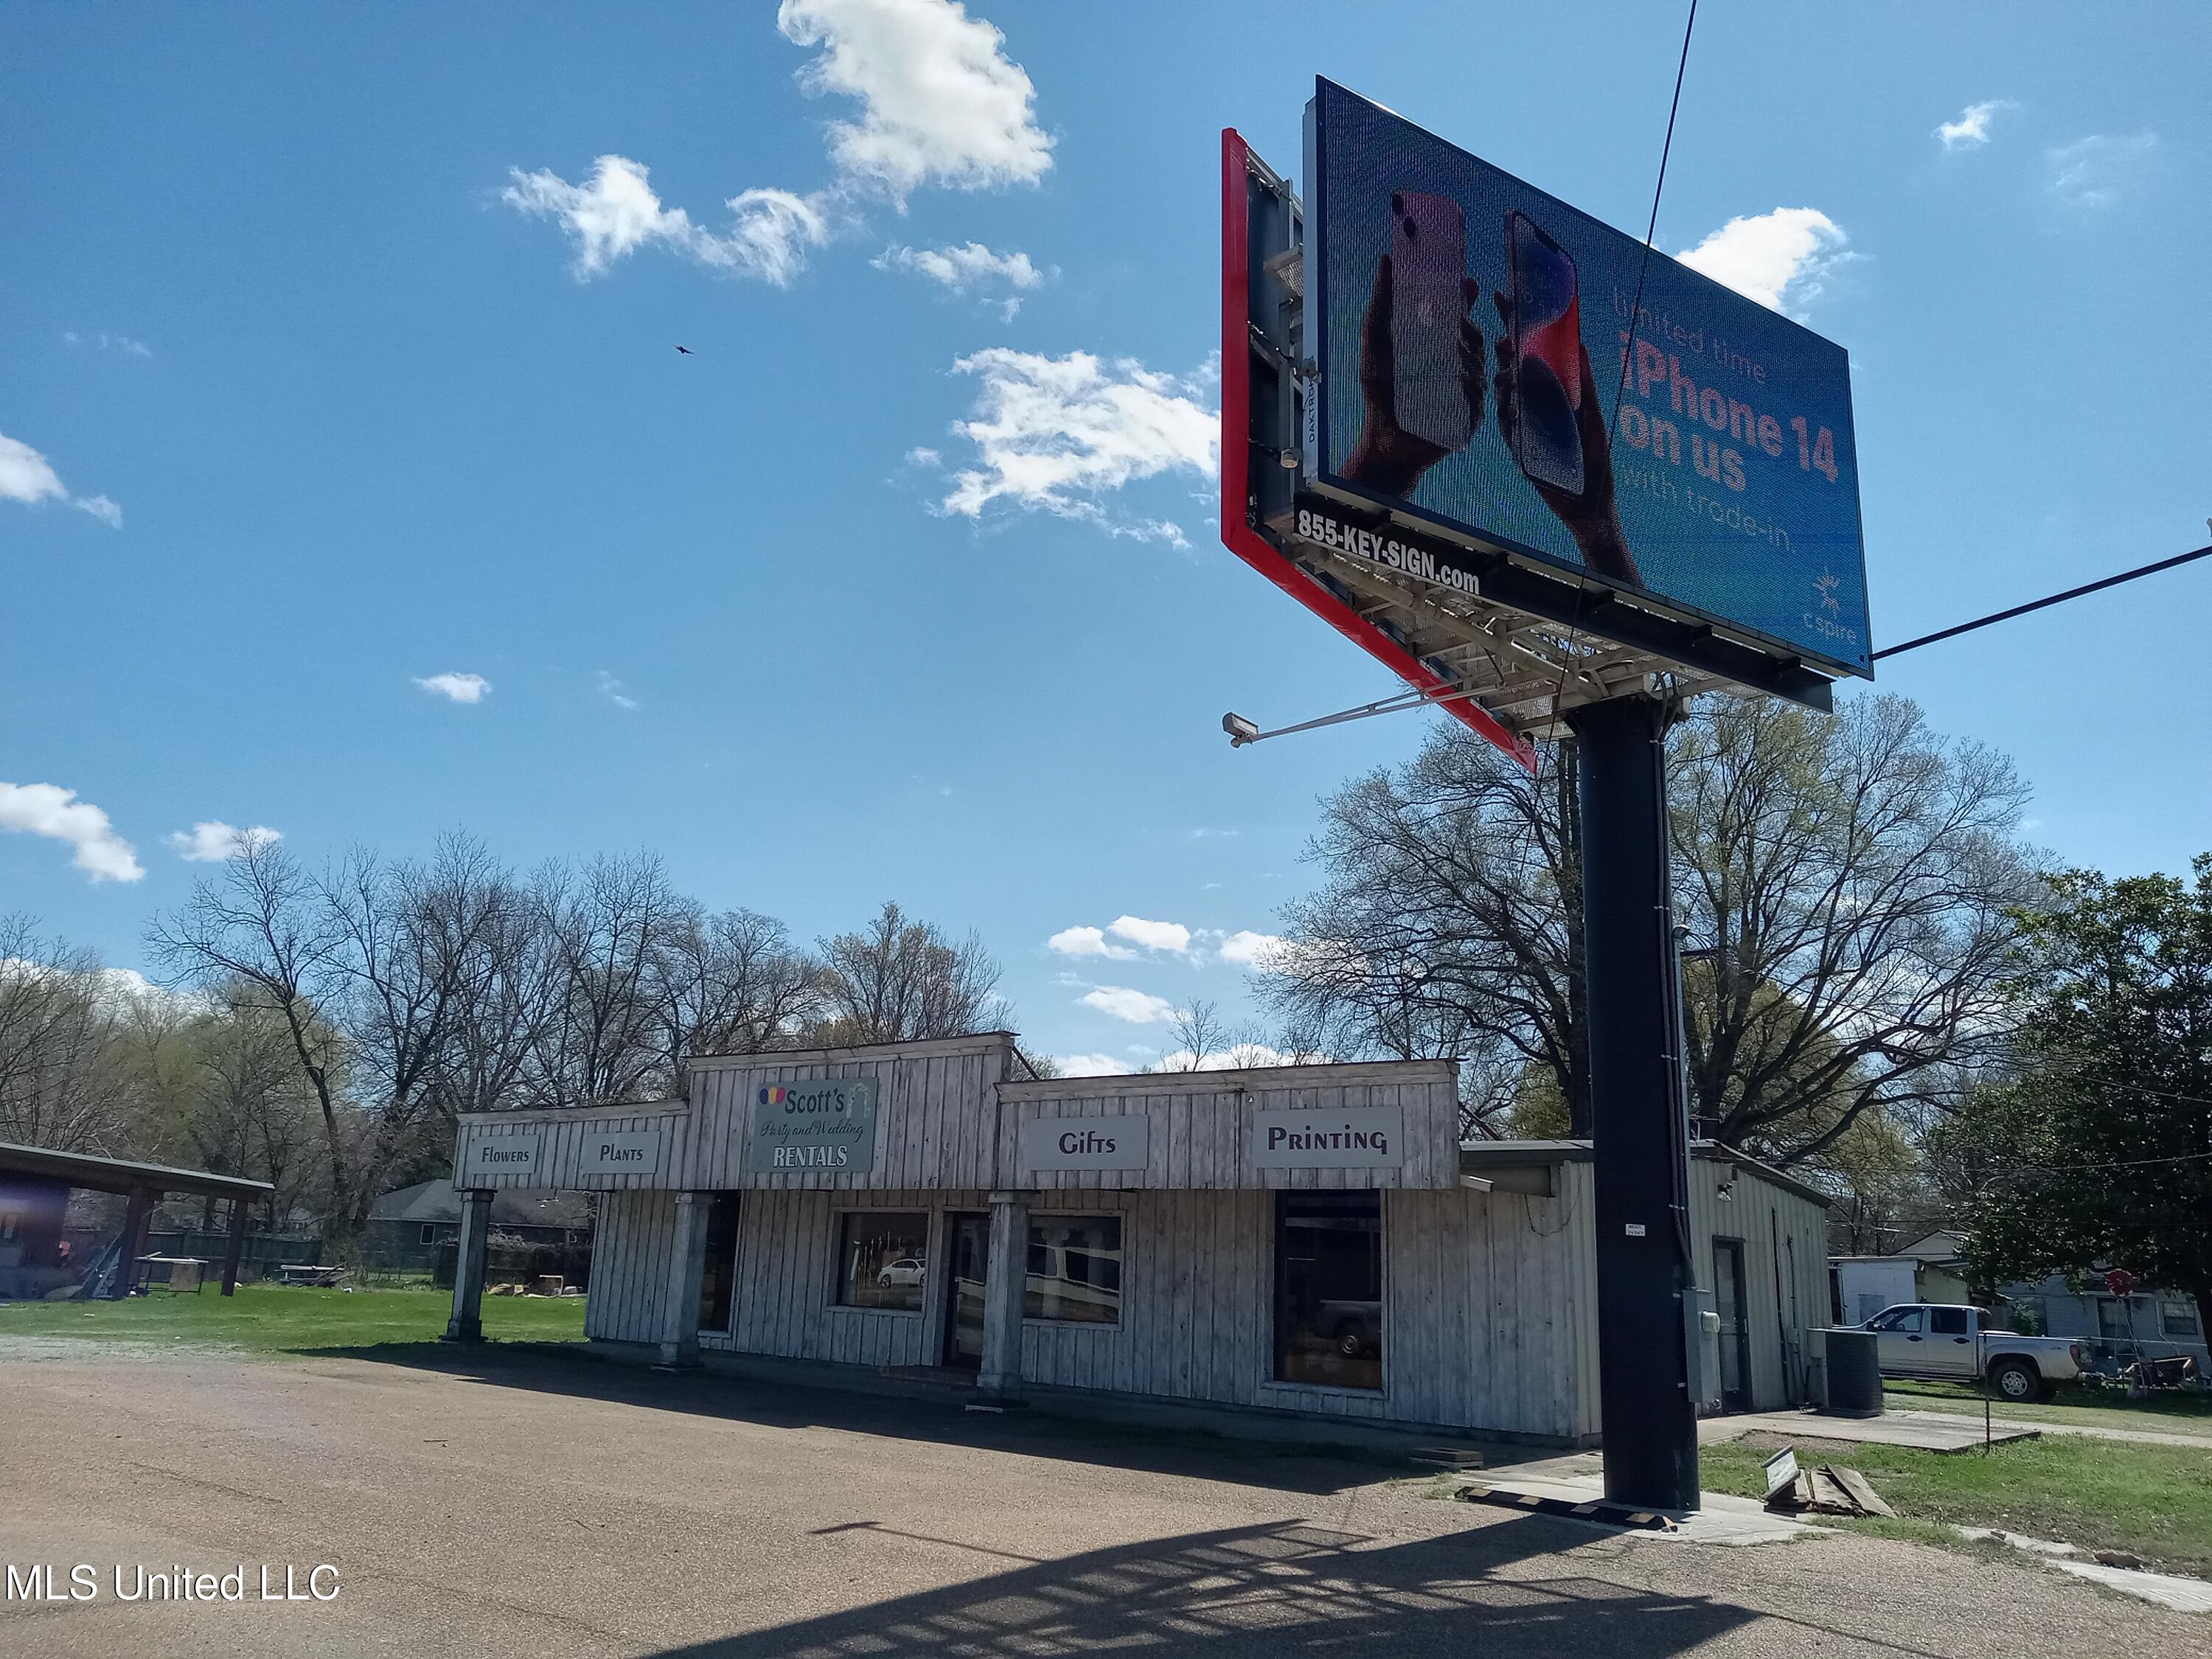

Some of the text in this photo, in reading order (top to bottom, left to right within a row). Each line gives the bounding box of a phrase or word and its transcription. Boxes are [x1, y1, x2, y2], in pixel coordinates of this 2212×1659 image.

[1713, 335, 1767, 384] time
[1620, 329, 1838, 484] iPhone 14
[1621, 404, 1747, 493] on us
[1623, 463, 1677, 506] with
[1298, 509, 1480, 595] 855-KEY-SIGN.com
[785, 1088, 845, 1114] Scott's
[760, 1118, 863, 1145] Party and Wedding
[1058, 1130, 1117, 1155] Gifts
[773, 1145, 848, 1168] RENTALS
